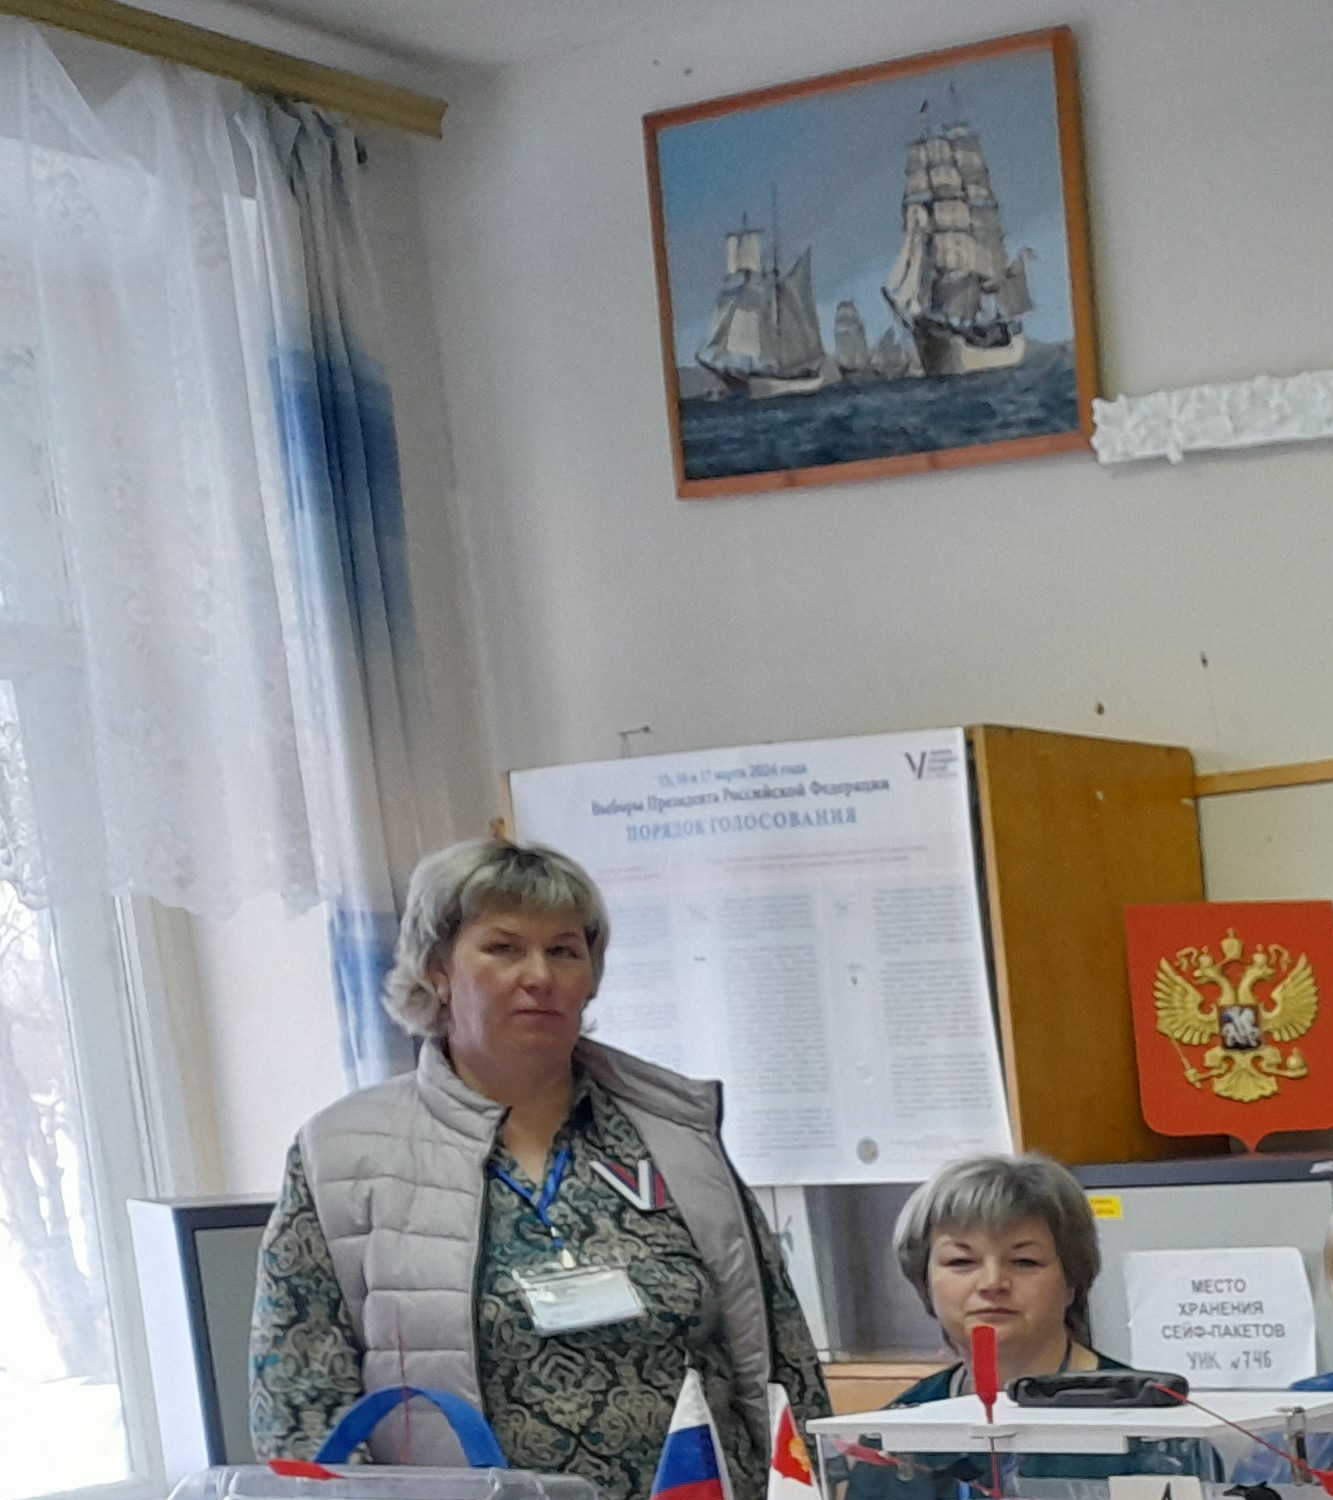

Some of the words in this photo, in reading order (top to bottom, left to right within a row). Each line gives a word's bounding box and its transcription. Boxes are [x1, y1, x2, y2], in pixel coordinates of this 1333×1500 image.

[627, 820, 705, 841] ПОРЯДОК
[710, 806, 857, 834] ГОЛОСОВАНИЯ
[1191, 1278, 1247, 1294] МЕСТО
[1178, 1300, 1264, 1316] ХРАНЕНИЯ
[1162, 1322, 1286, 1339] СЕЙФ-ПАКЕТОВ
[1186, 1351, 1221, 1370] УИК
